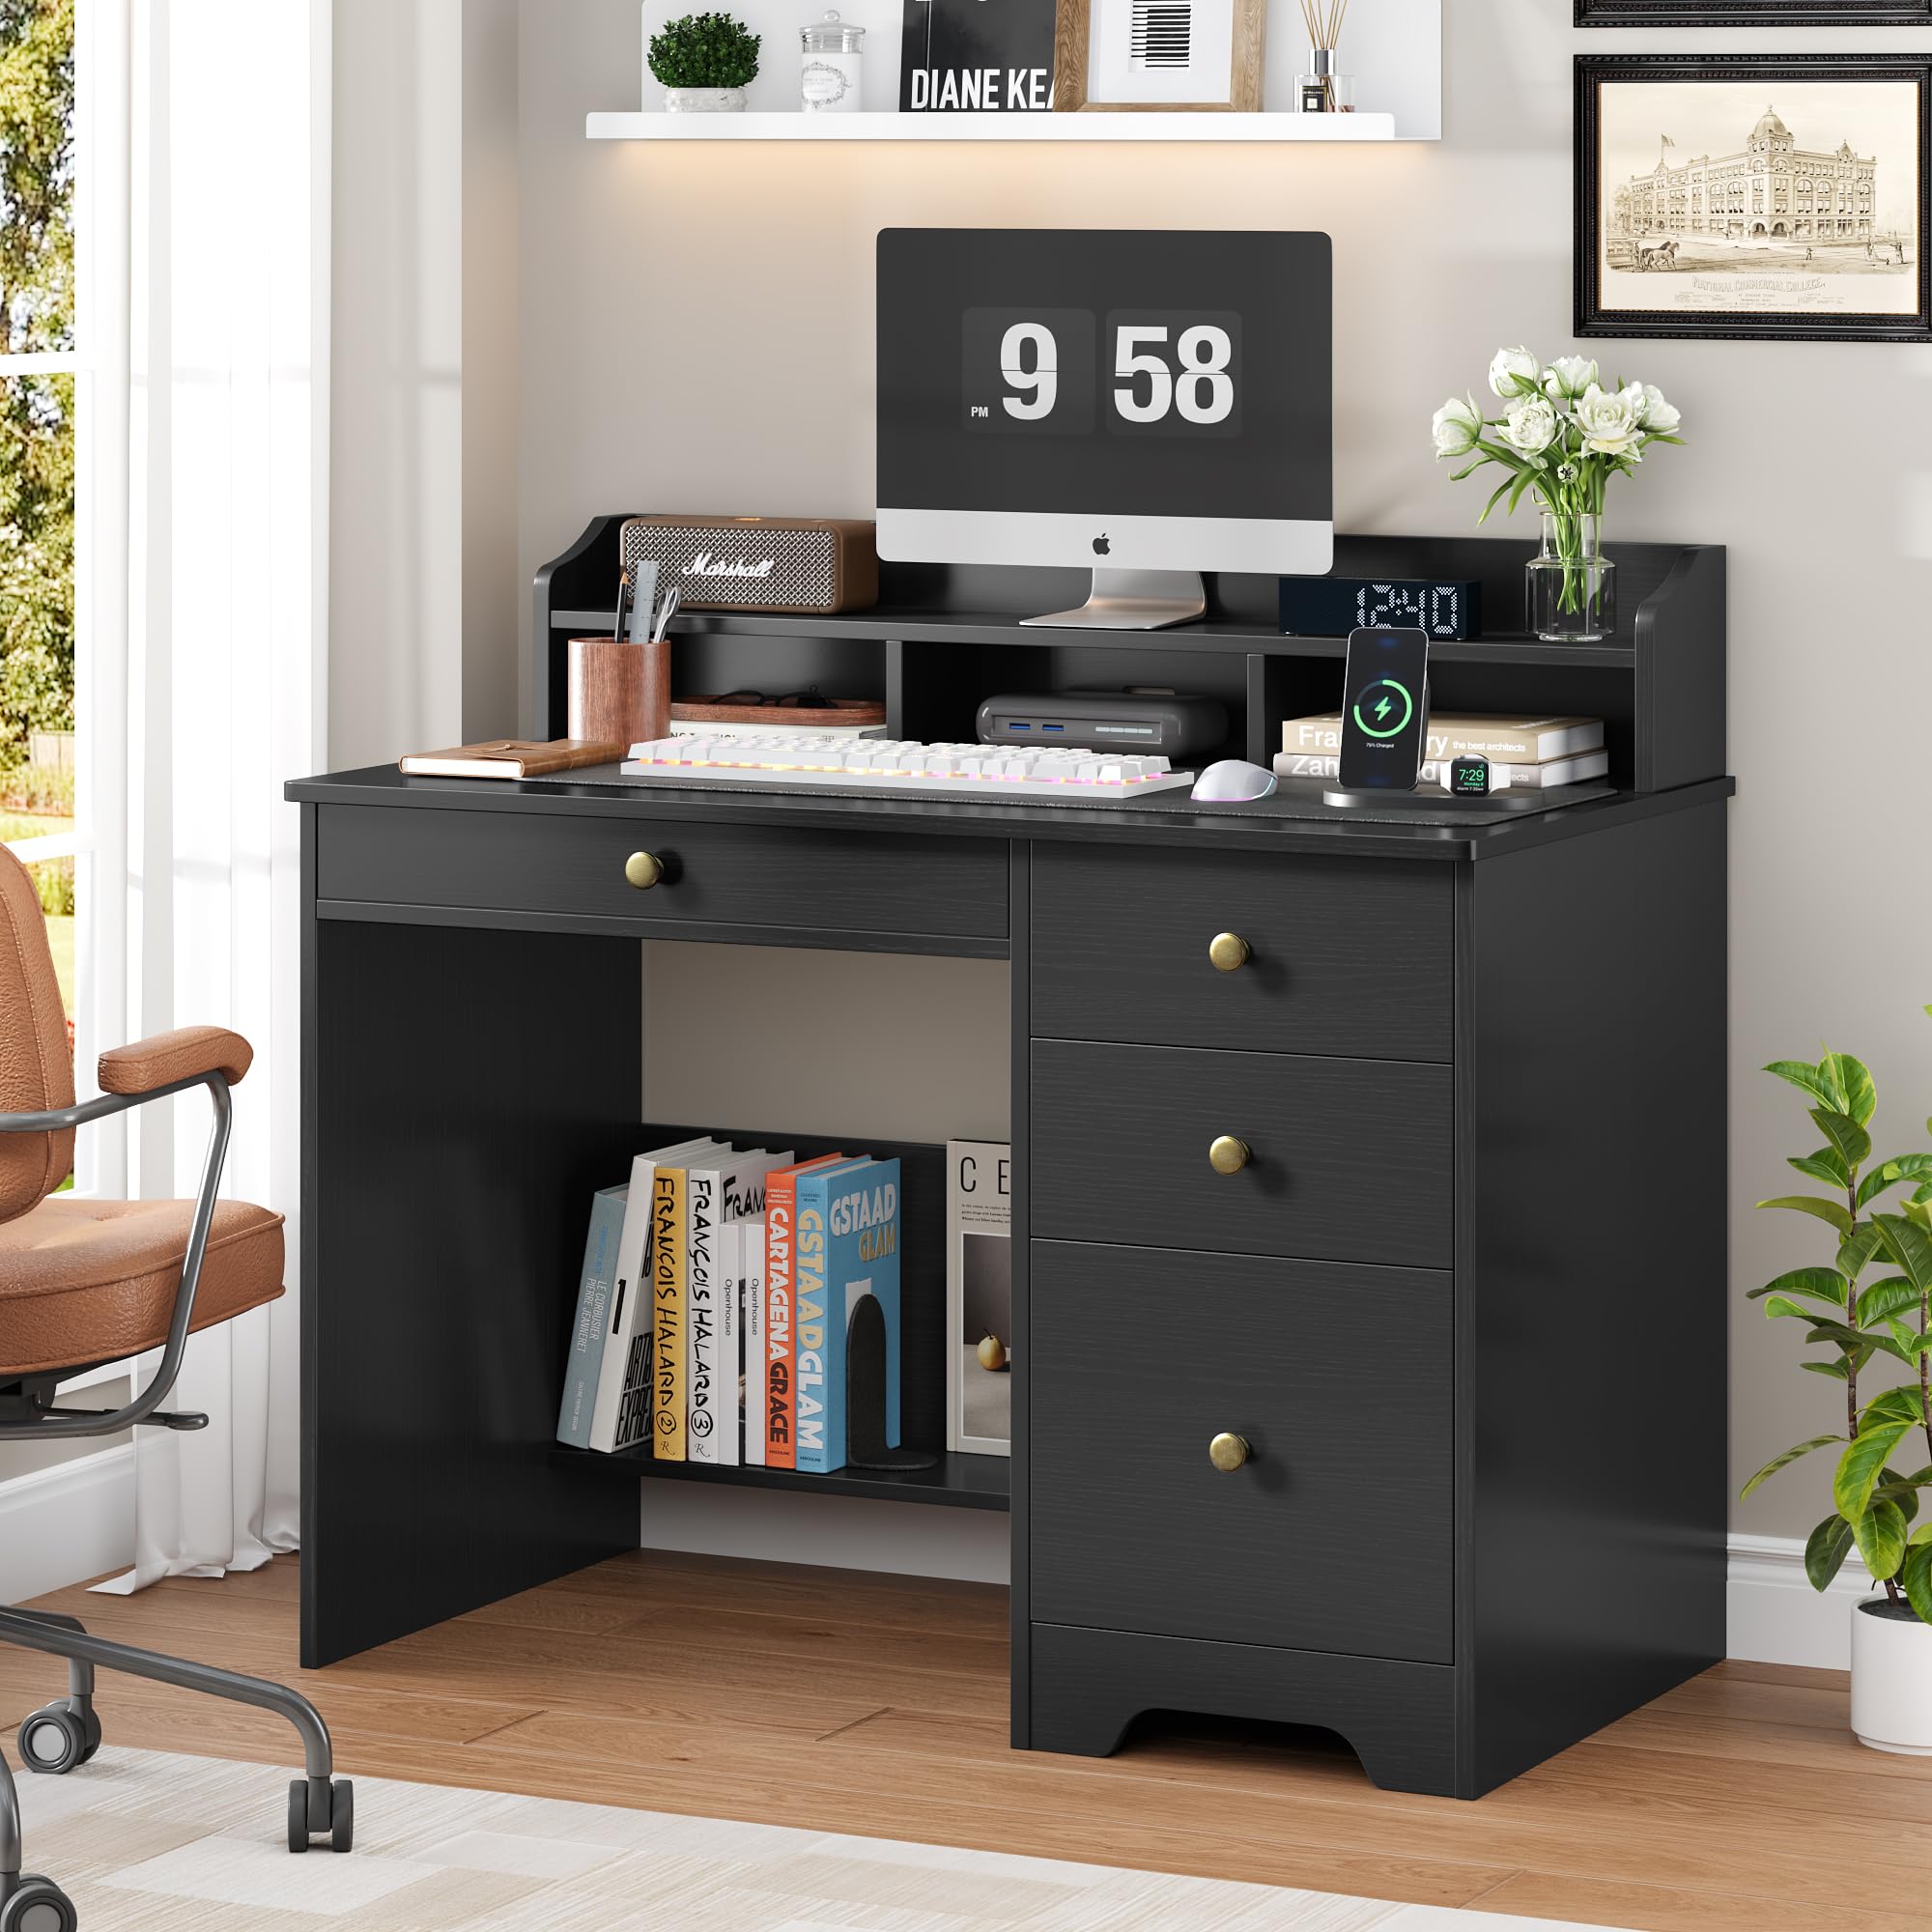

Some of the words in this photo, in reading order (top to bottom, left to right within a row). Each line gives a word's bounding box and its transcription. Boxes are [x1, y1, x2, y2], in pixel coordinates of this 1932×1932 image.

[911, 69, 1001, 109] DIANE
[971, 406, 989, 418] PM
[1000, 322, 1058, 420] 9
[1114, 325, 1235, 424] 58
[682, 552, 775, 579] Marshall
[1355, 584, 1459, 635] 12:40
[1291, 754, 1339, 777] Zah
[1509, 773, 1529, 781] ects
[1298, 724, 1339, 748] Fra
[1425, 734, 1449, 757] ry
[1453, 741, 1466, 750] the
[1467, 742, 1486, 752] best
[1487, 743, 1526, 753] architects
[1459, 769, 1485, 781] 7:29
[830, 1183, 896, 1236] GSTAAD
[656, 1177, 677, 1300] FRANÇOIS
[689, 1179, 712, 1302] FRANÇOIS
[859, 1221, 896, 1263] GLAM
[582, 1277, 597, 1306] PIERRE
[769, 1208, 789, 1361] CARTAGENA
[798, 1208, 824, 1350] GSTAAD
[576, 1306, 592, 1353] JEANNERET
[588, 1293, 606, 1340] CORBUSIER
[724, 1279, 733, 1336] Openhouse
[751, 1279, 759, 1336] Openhouse
[657, 1307, 678, 1406] HALARD
[691, 1308, 713, 1408] HALARD
[769, 1362, 789, 1443] GRACE
[798, 1350, 824, 1450] GLAM
